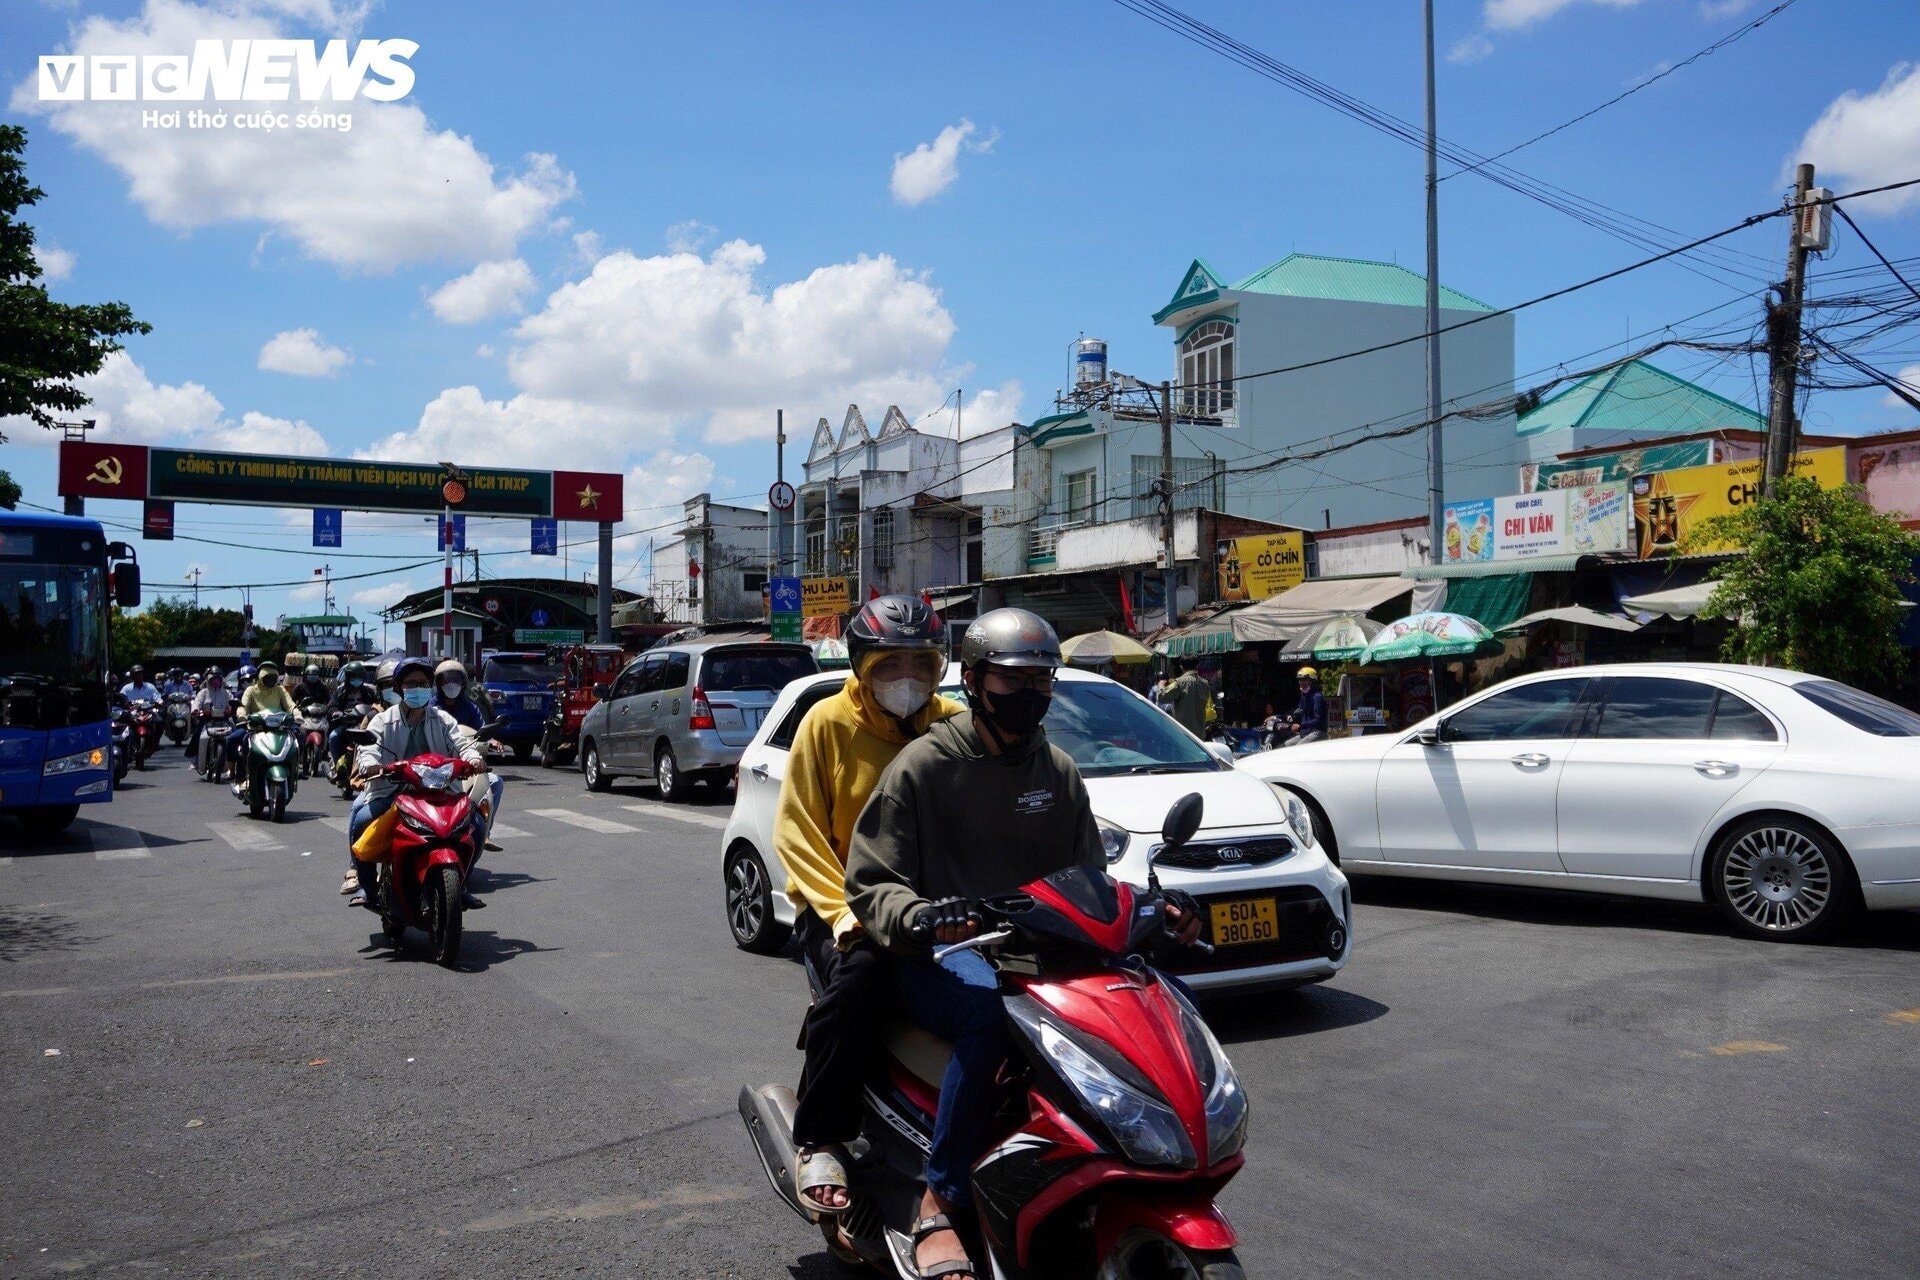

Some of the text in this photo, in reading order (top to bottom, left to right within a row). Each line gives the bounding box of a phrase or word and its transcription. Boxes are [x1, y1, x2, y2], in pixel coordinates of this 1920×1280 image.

[176, 454, 215, 475] CÔNG
[217, 461, 236, 475] TY
[238, 462, 274, 479] TNHH
[275, 461, 304, 483] MỘT
[307, 463, 352, 483] THÀNH
[355, 465, 384, 484] VIÊN
[386, 470, 417, 489] DỊCH
[419, 472, 437, 490] VỤ
[474, 471, 495, 490] ÍCH
[497, 477, 530, 491] TNXP
[776, 487, 782, 504] 4
[1504, 512, 1553, 539] CHỊ VÂN
[1257, 548, 1299, 566] CÔ CHÍN
[820, 580, 845, 593] LÂM
[1223, 848, 1241, 858] KIA
[1230, 902, 1258, 921] 60A
[1221, 920, 1272, 943] 380.60
